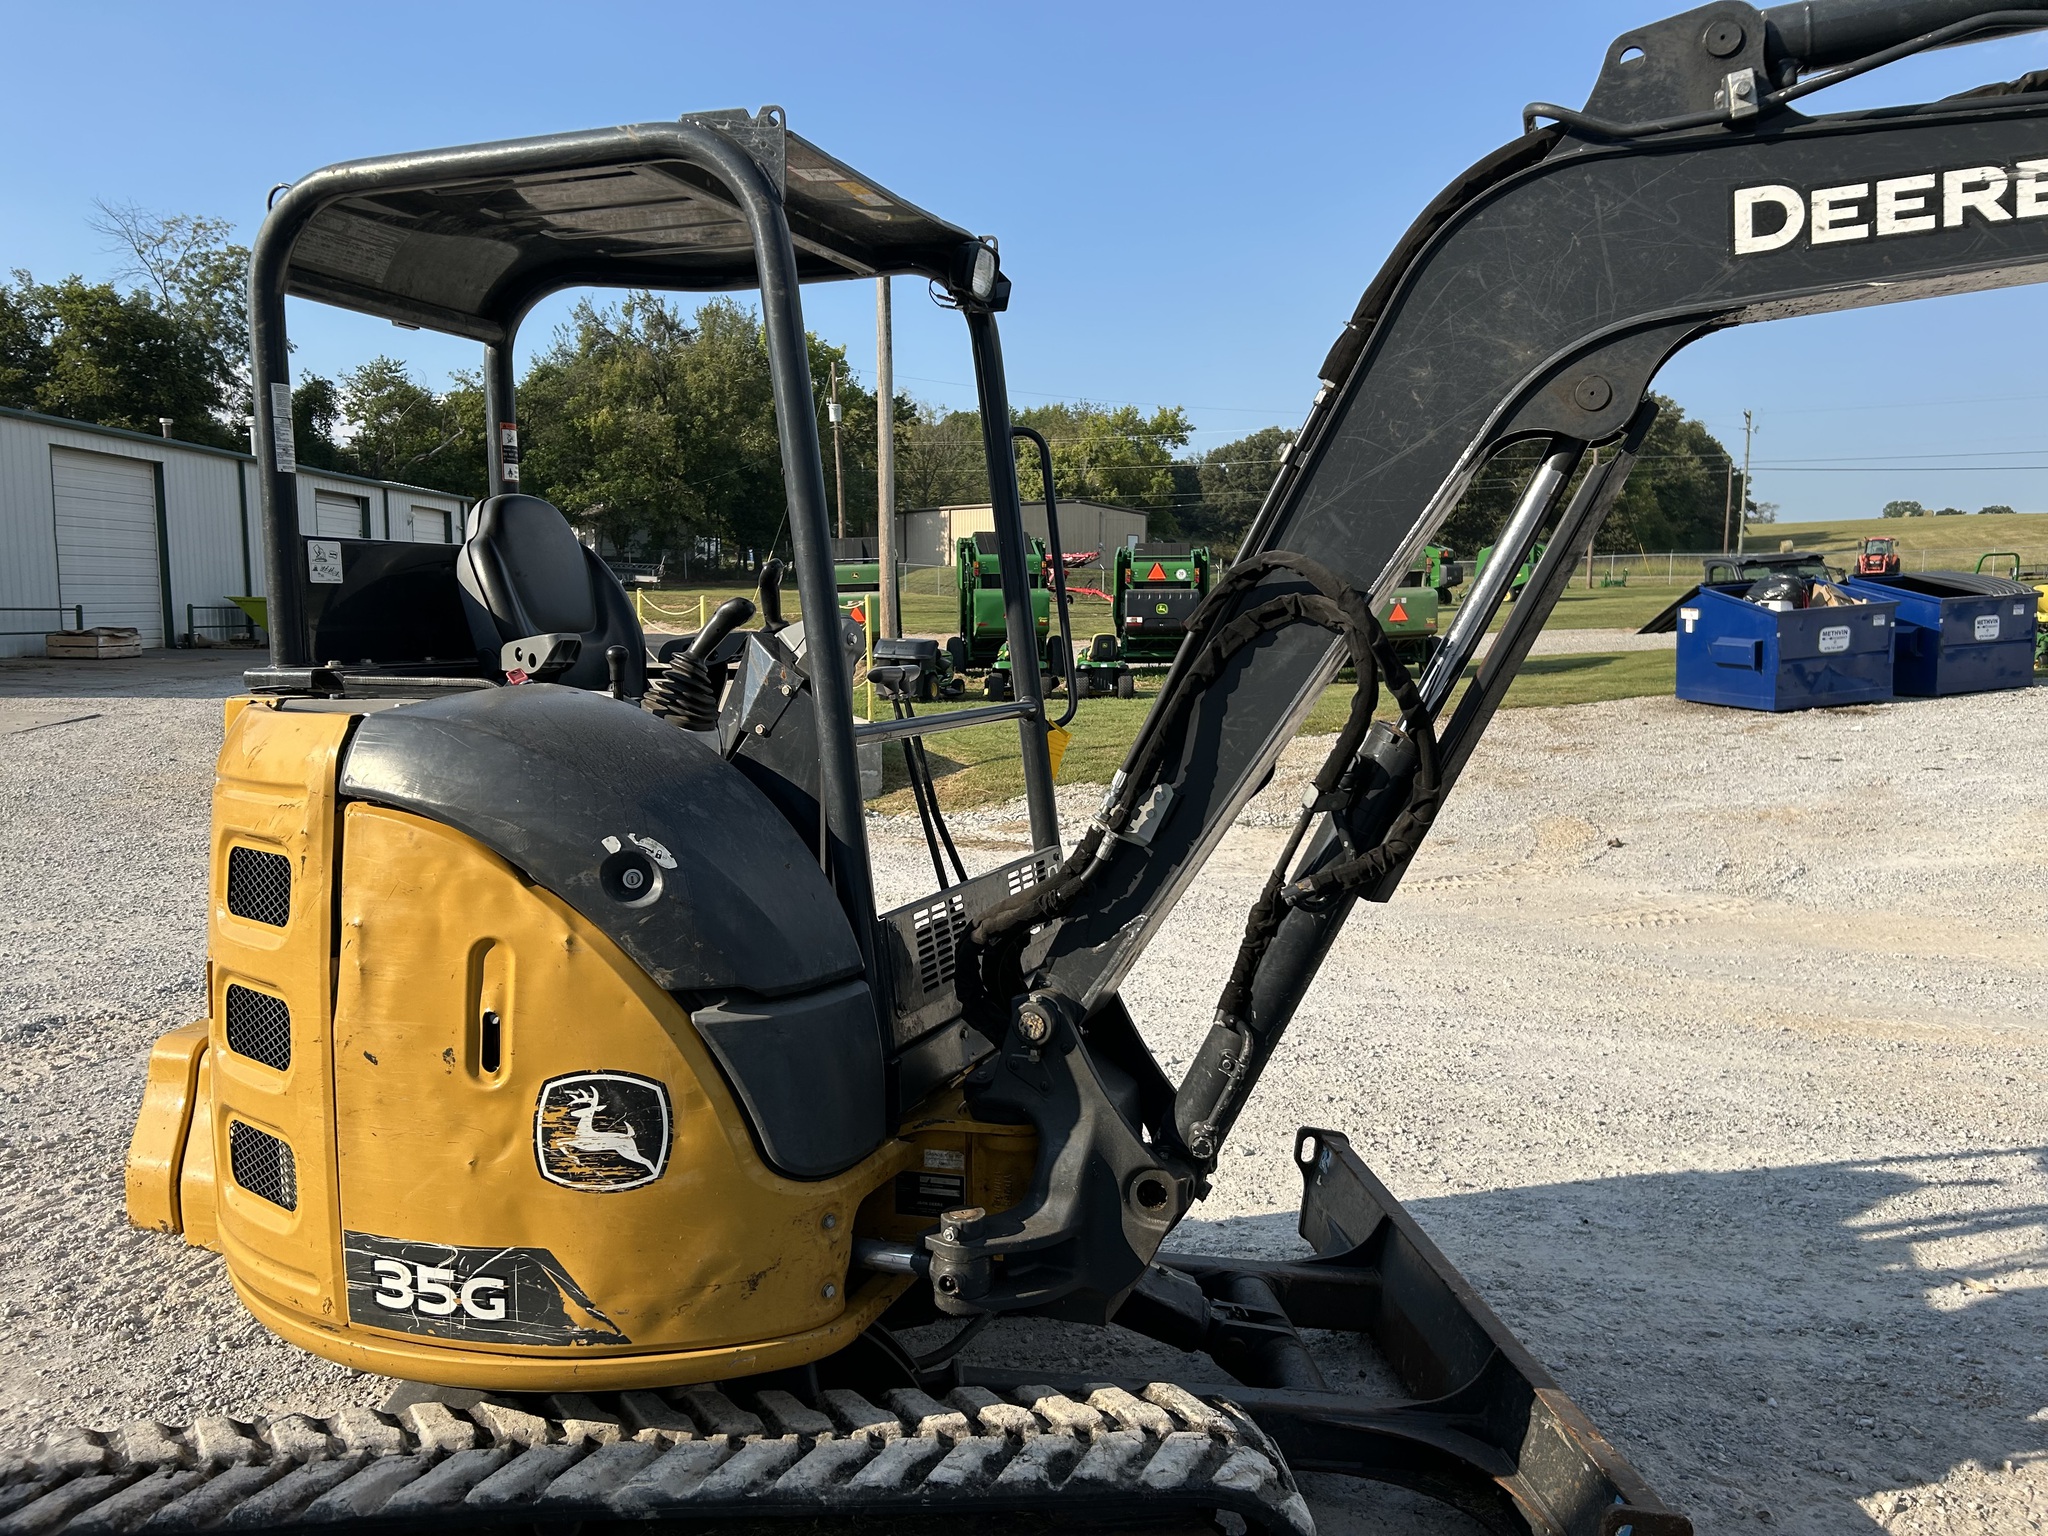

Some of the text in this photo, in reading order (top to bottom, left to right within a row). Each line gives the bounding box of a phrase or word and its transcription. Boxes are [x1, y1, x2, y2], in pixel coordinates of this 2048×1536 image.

[1734, 158, 2048, 256] DEERE
[1822, 629, 1848, 637] METHVIN
[373, 1259, 506, 1321] 35G
